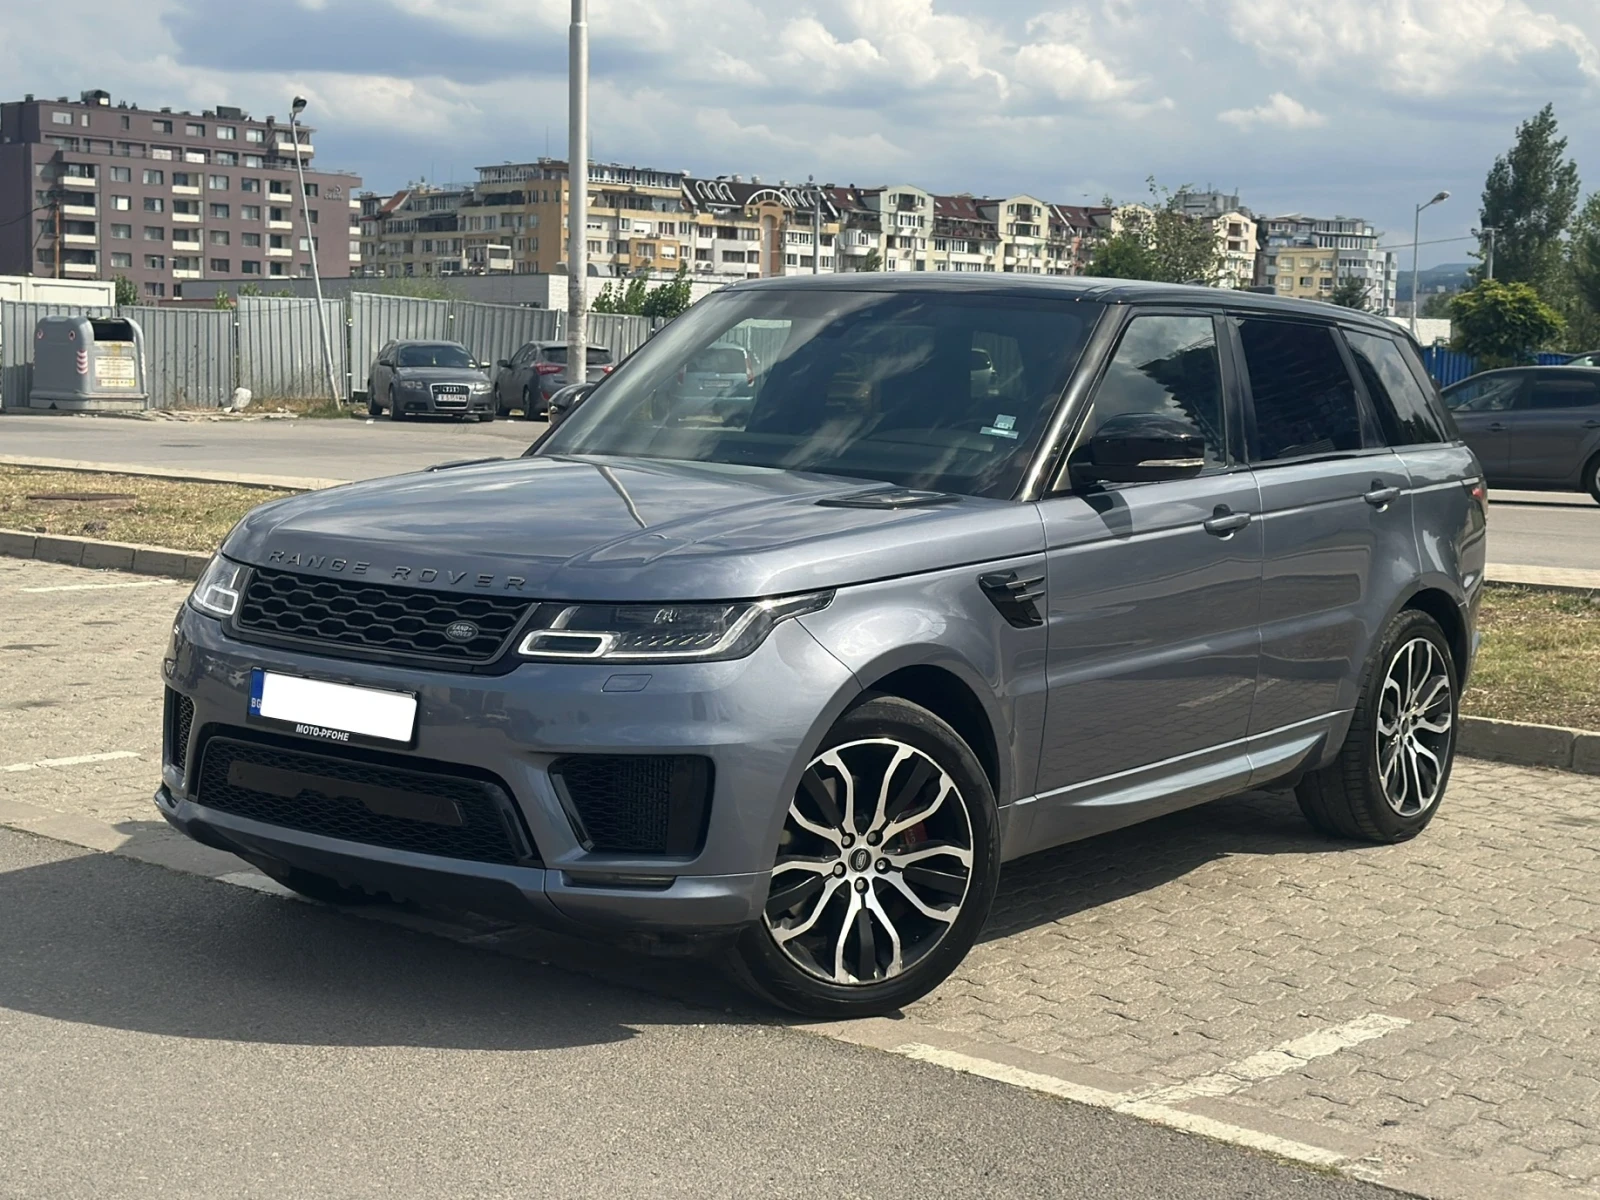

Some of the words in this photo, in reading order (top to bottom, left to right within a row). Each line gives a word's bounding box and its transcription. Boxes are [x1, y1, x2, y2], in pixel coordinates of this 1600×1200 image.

[268, 550, 371, 575] RANGE
[391, 565, 526, 591] ROVER
[251, 697, 262, 709] BG
[295, 723, 350, 742] MOTO-PFOHE
